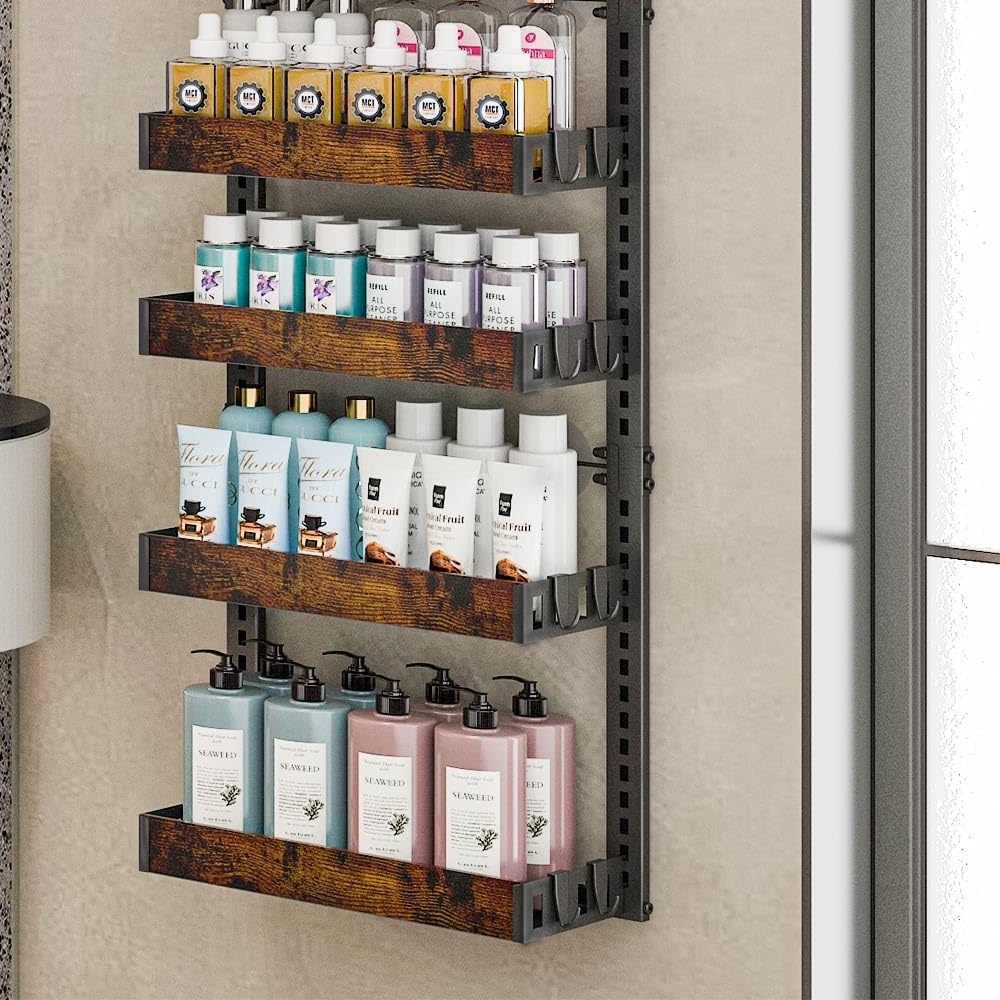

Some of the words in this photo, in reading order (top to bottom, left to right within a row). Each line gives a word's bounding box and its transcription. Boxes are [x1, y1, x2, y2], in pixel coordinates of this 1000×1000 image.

[185, 89, 198, 97] MCT
[243, 92, 256, 101] MCT
[301, 96, 315, 104] MCT
[361, 98, 375, 107] MCT
[422, 102, 436, 110] MCT
[485, 105, 499, 113] MCT
[372, 296, 384, 304] ALL
[368, 305, 397, 314] RPOSE
[430, 301, 442, 309] ALL
[426, 310, 456, 319] RPOSE
[488, 306, 501, 314] ALL
[485, 315, 515, 324] RPOSE
[181, 443, 224, 464] Flora
[240, 449, 283, 471] Flora
[301, 456, 346, 479] Flora
[377, 507, 399, 516] Fruit
[442, 515, 464, 524] Fruit
[509, 523, 531, 532] Fruit
[198, 750, 237, 759] SEAWEED
[280, 763, 320, 773] SEAWEED
[364, 777, 406, 787] SEAWEED
[452, 792, 494, 802] SEAWEED
